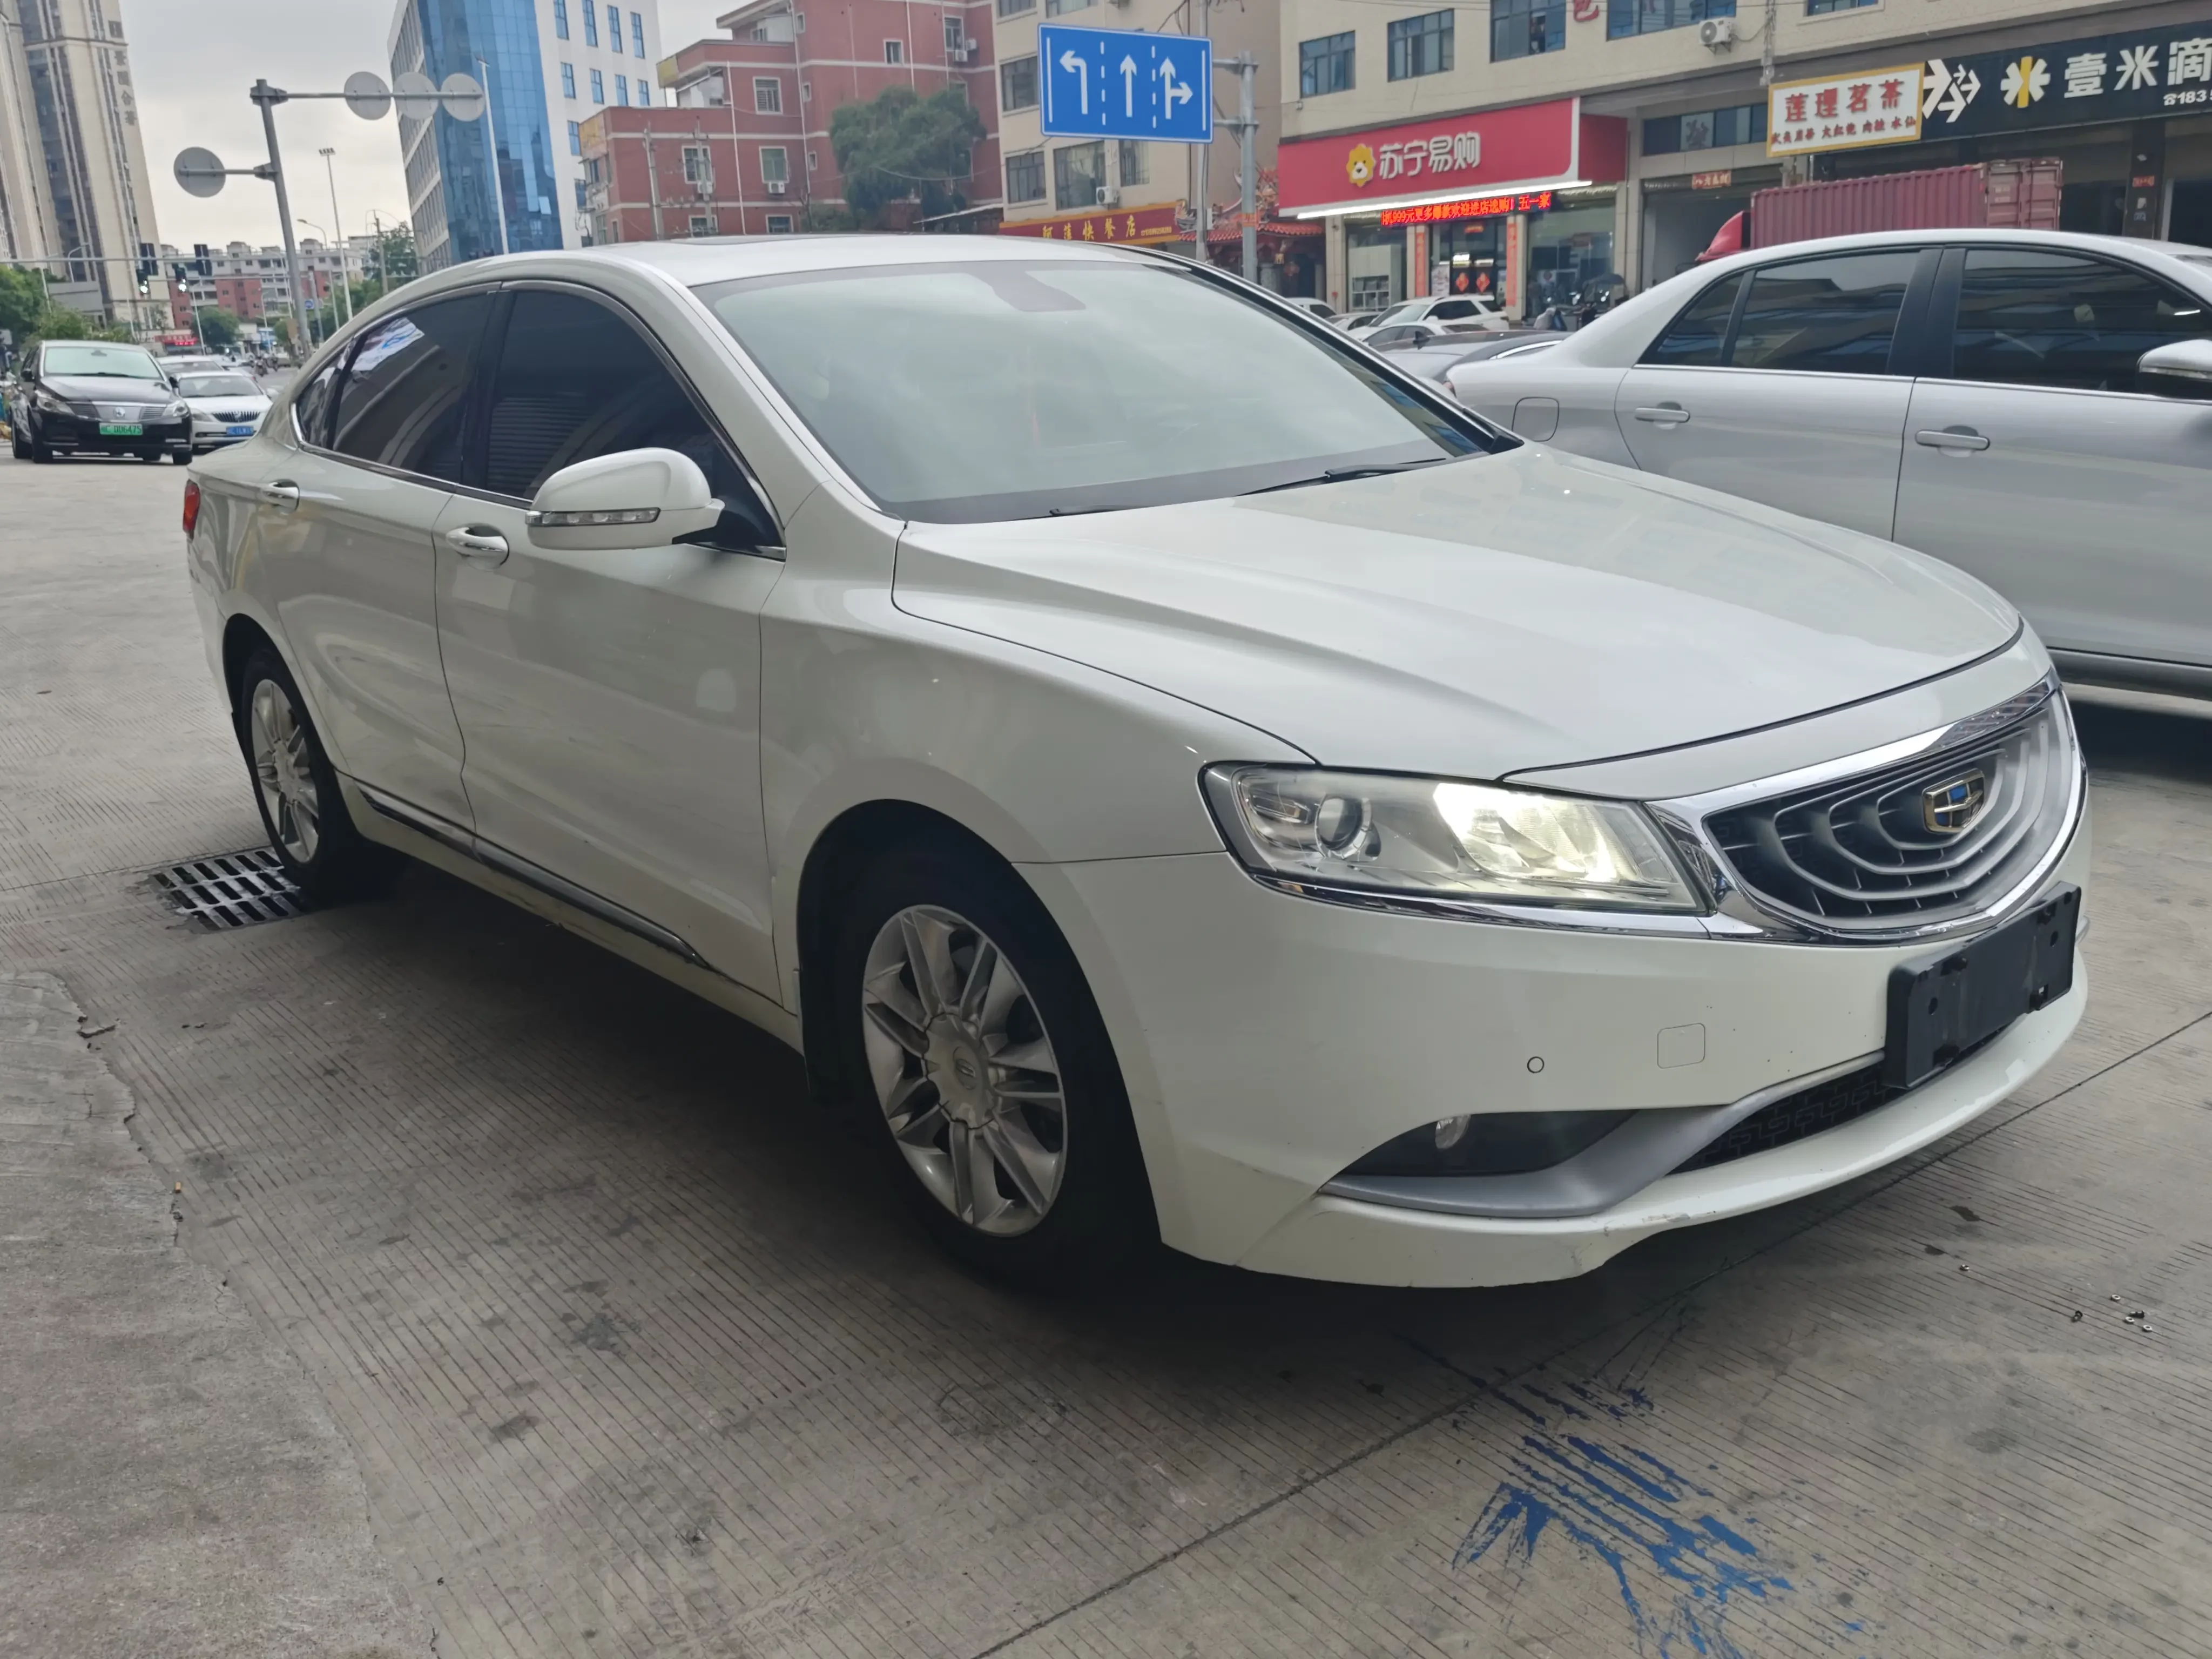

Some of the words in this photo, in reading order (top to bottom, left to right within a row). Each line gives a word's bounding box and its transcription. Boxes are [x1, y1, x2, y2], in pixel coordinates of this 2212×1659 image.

[2064, 38, 2212, 98] 壹米滴
[1379, 131, 1481, 179] 苏宁易购
